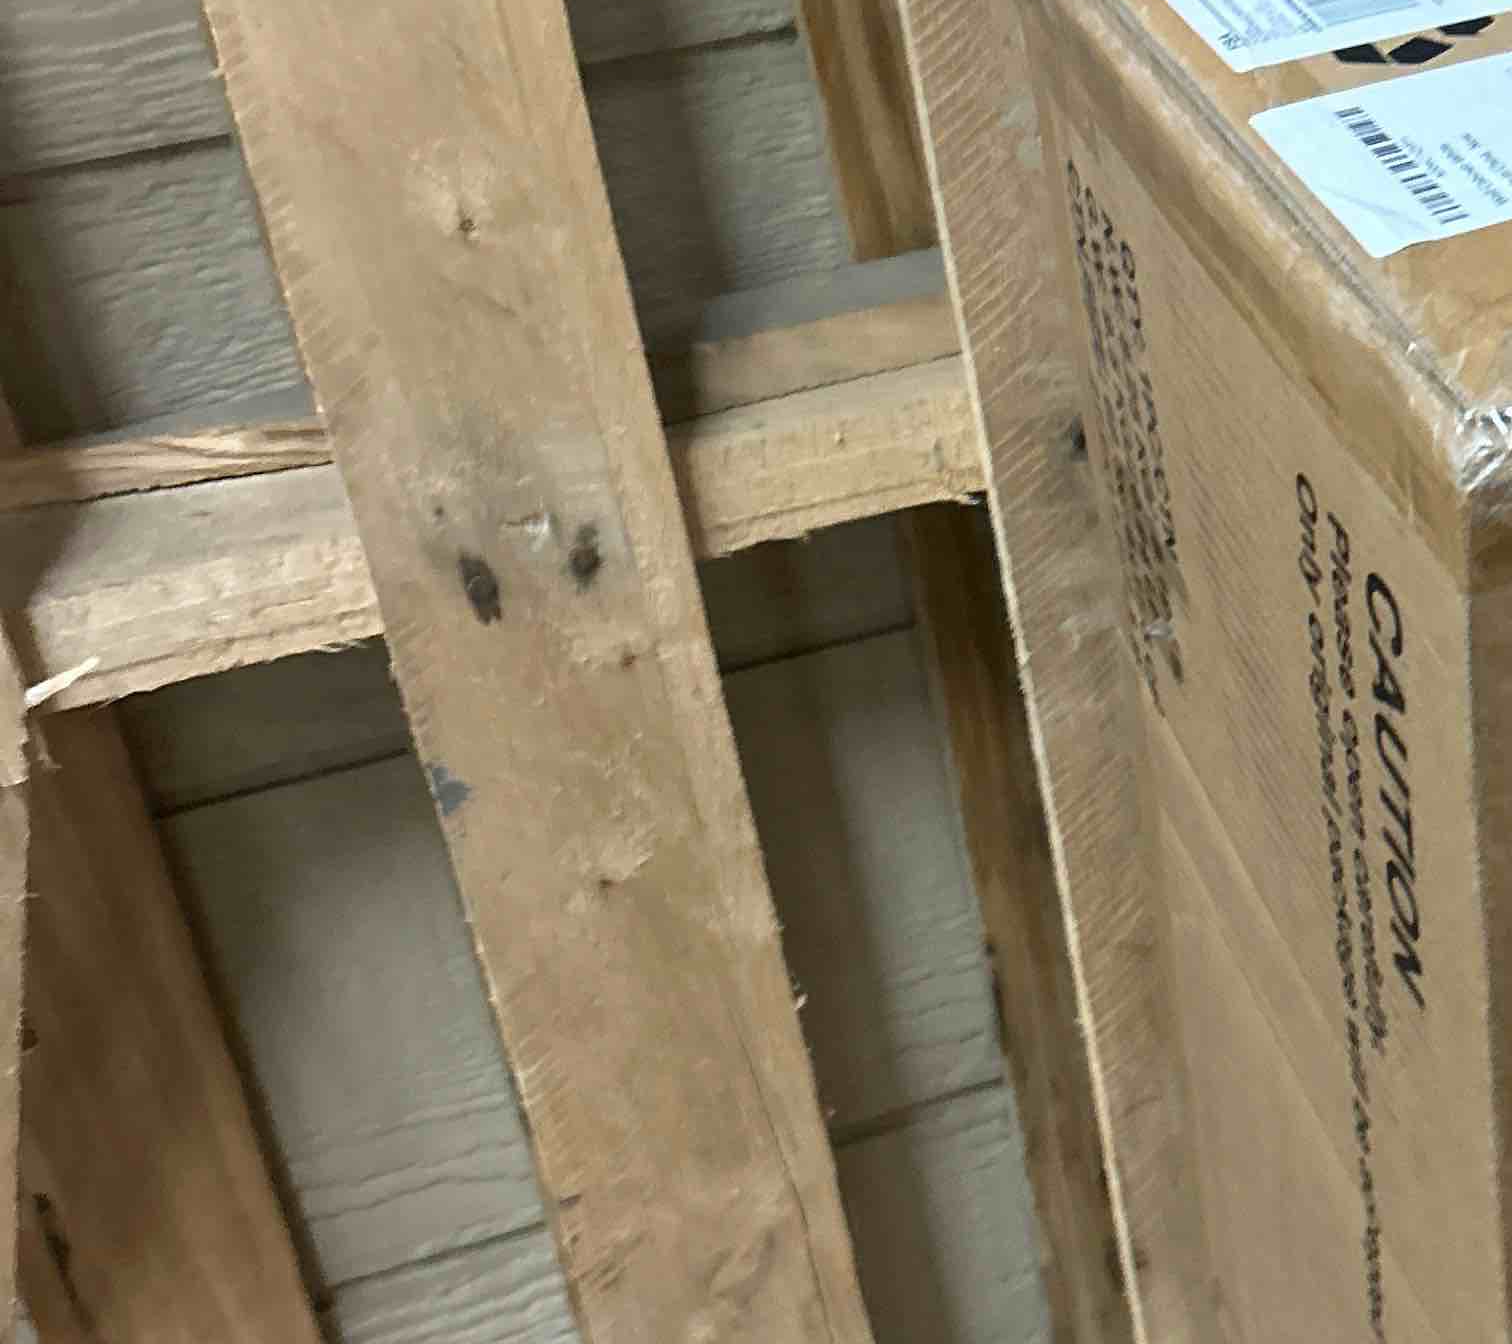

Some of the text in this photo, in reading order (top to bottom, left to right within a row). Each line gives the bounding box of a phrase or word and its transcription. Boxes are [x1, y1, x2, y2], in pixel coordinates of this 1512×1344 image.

[1295, 471, 1321, 608] Only
[1327, 512, 1353, 699] Please
[1365, 572, 1425, 1008] CAUTION
